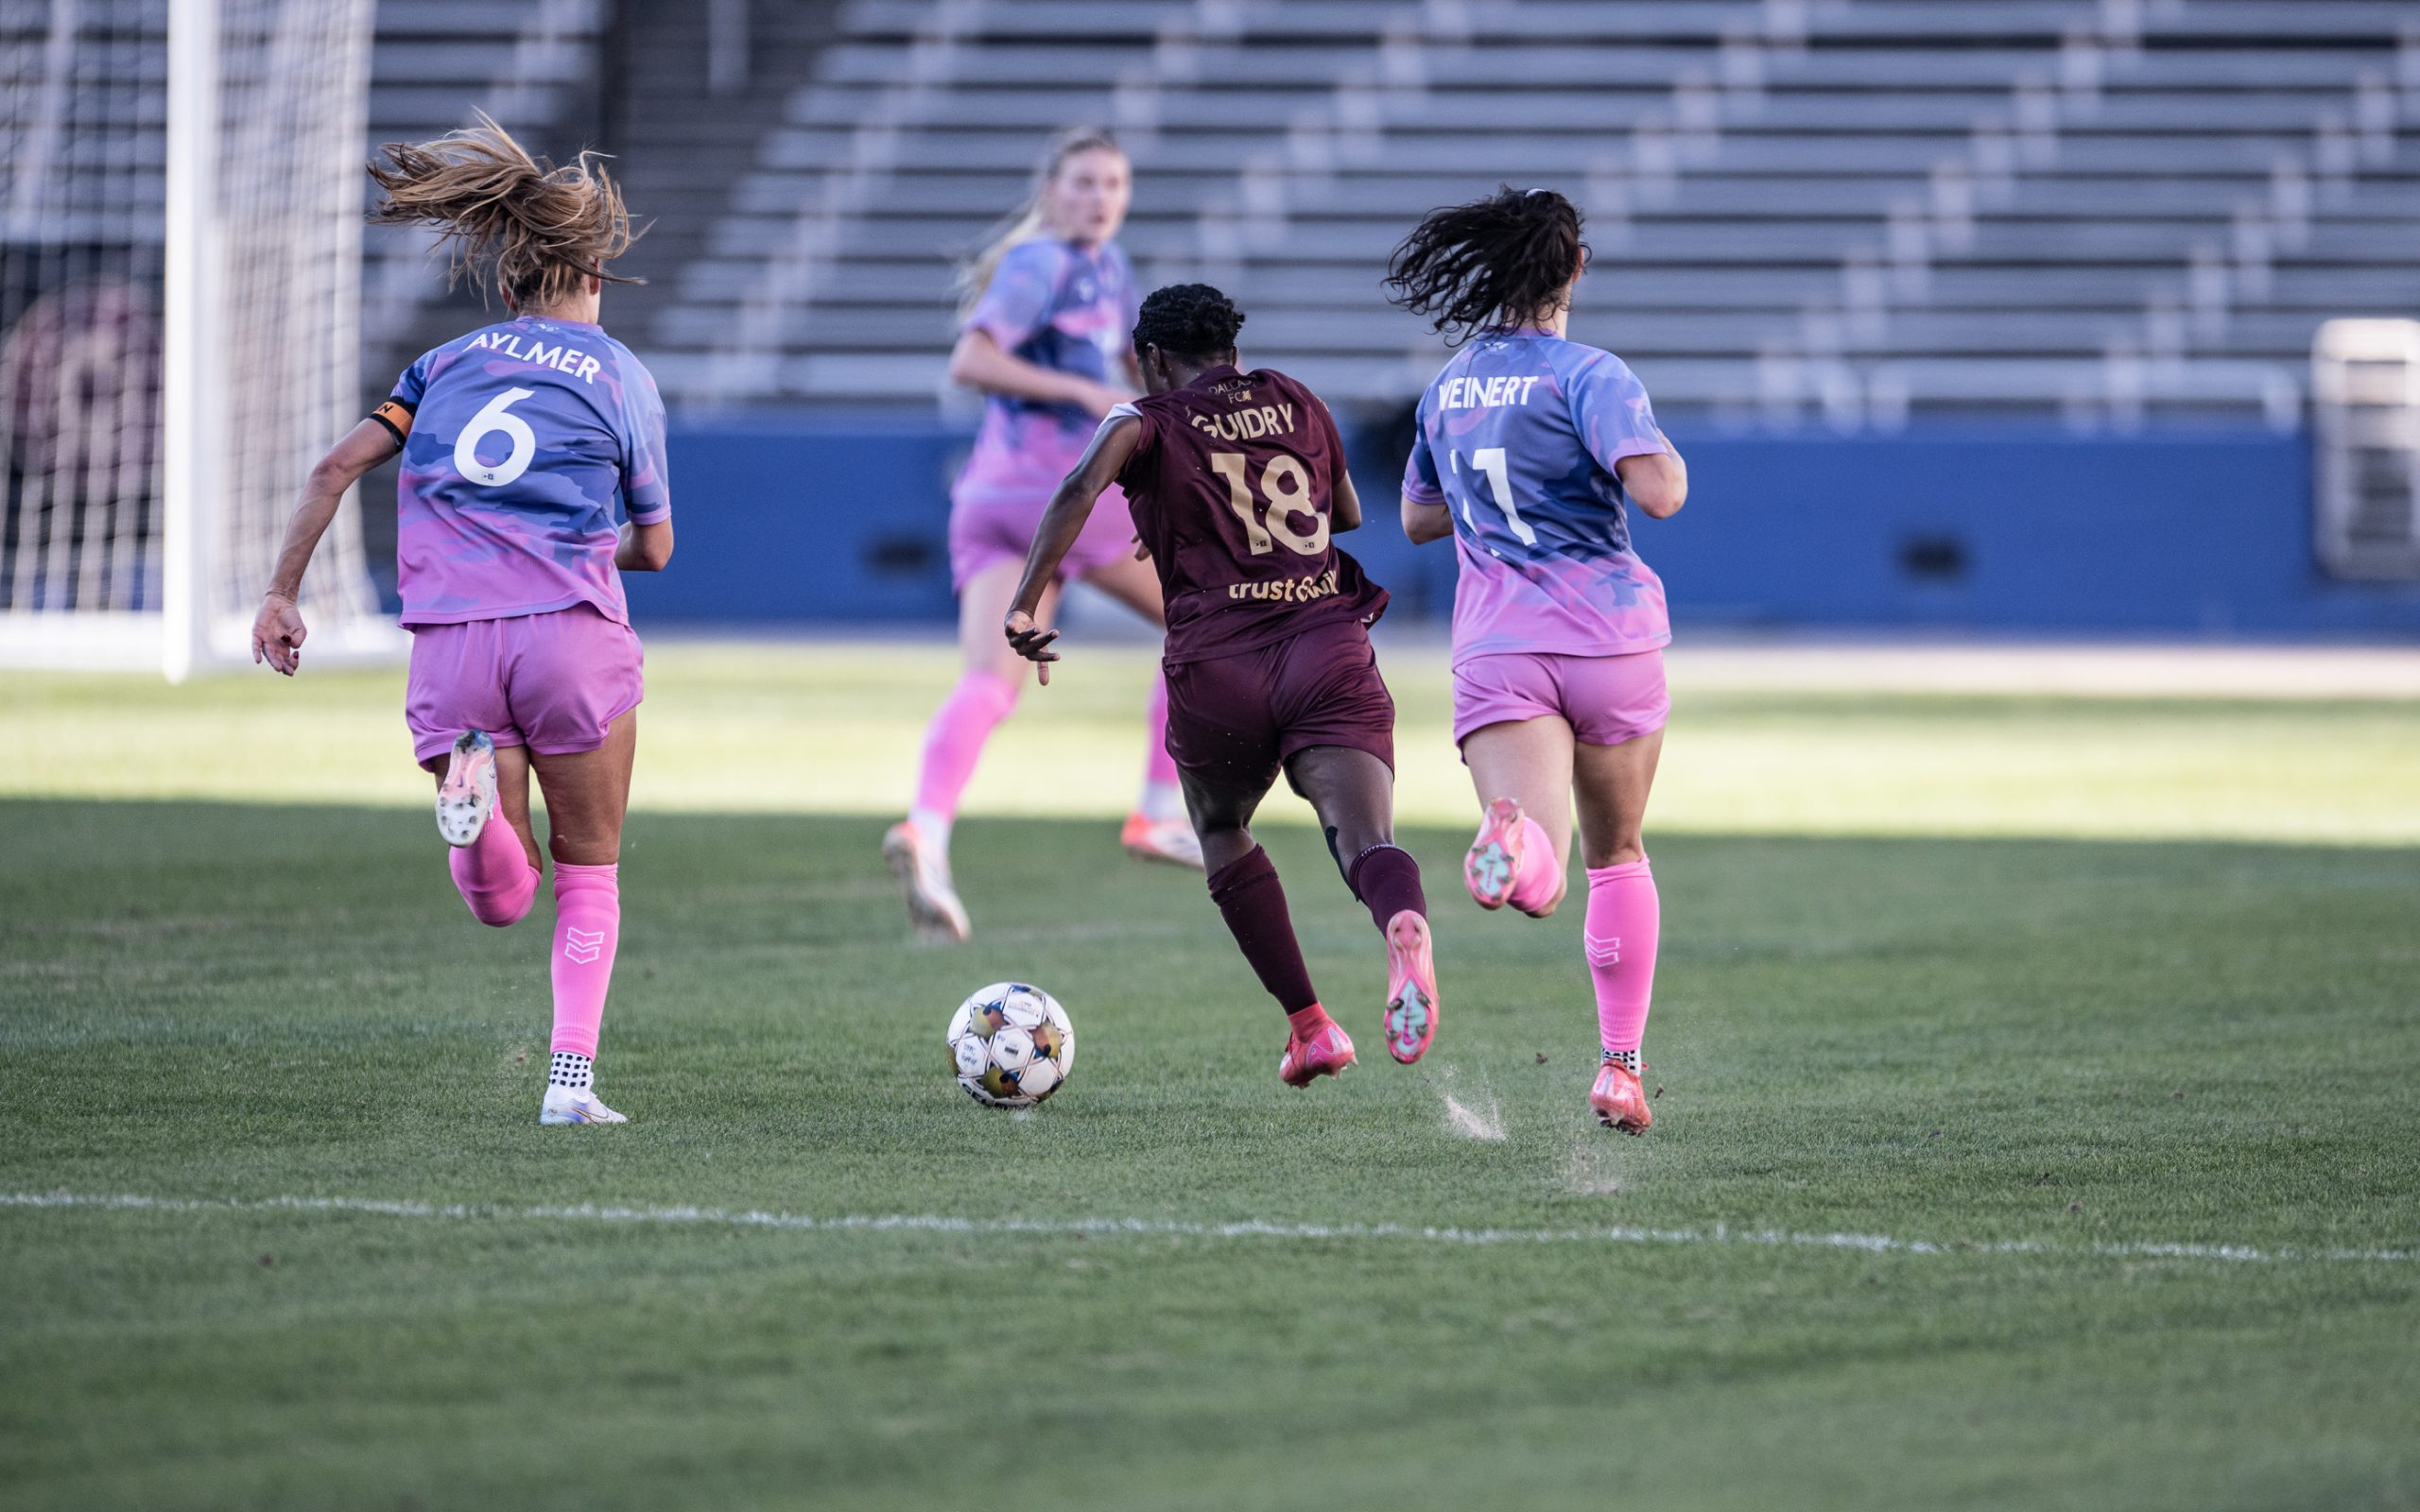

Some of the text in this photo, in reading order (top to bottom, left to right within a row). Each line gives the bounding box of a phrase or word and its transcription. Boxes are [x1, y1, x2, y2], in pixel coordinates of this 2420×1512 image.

[461, 332, 600, 385] AYLMER
[453, 387, 536, 487] 6
[1191, 403, 1295, 441] GUIDRY
[1211, 453, 1329, 556] 18
[1449, 448, 1537, 558] 1
